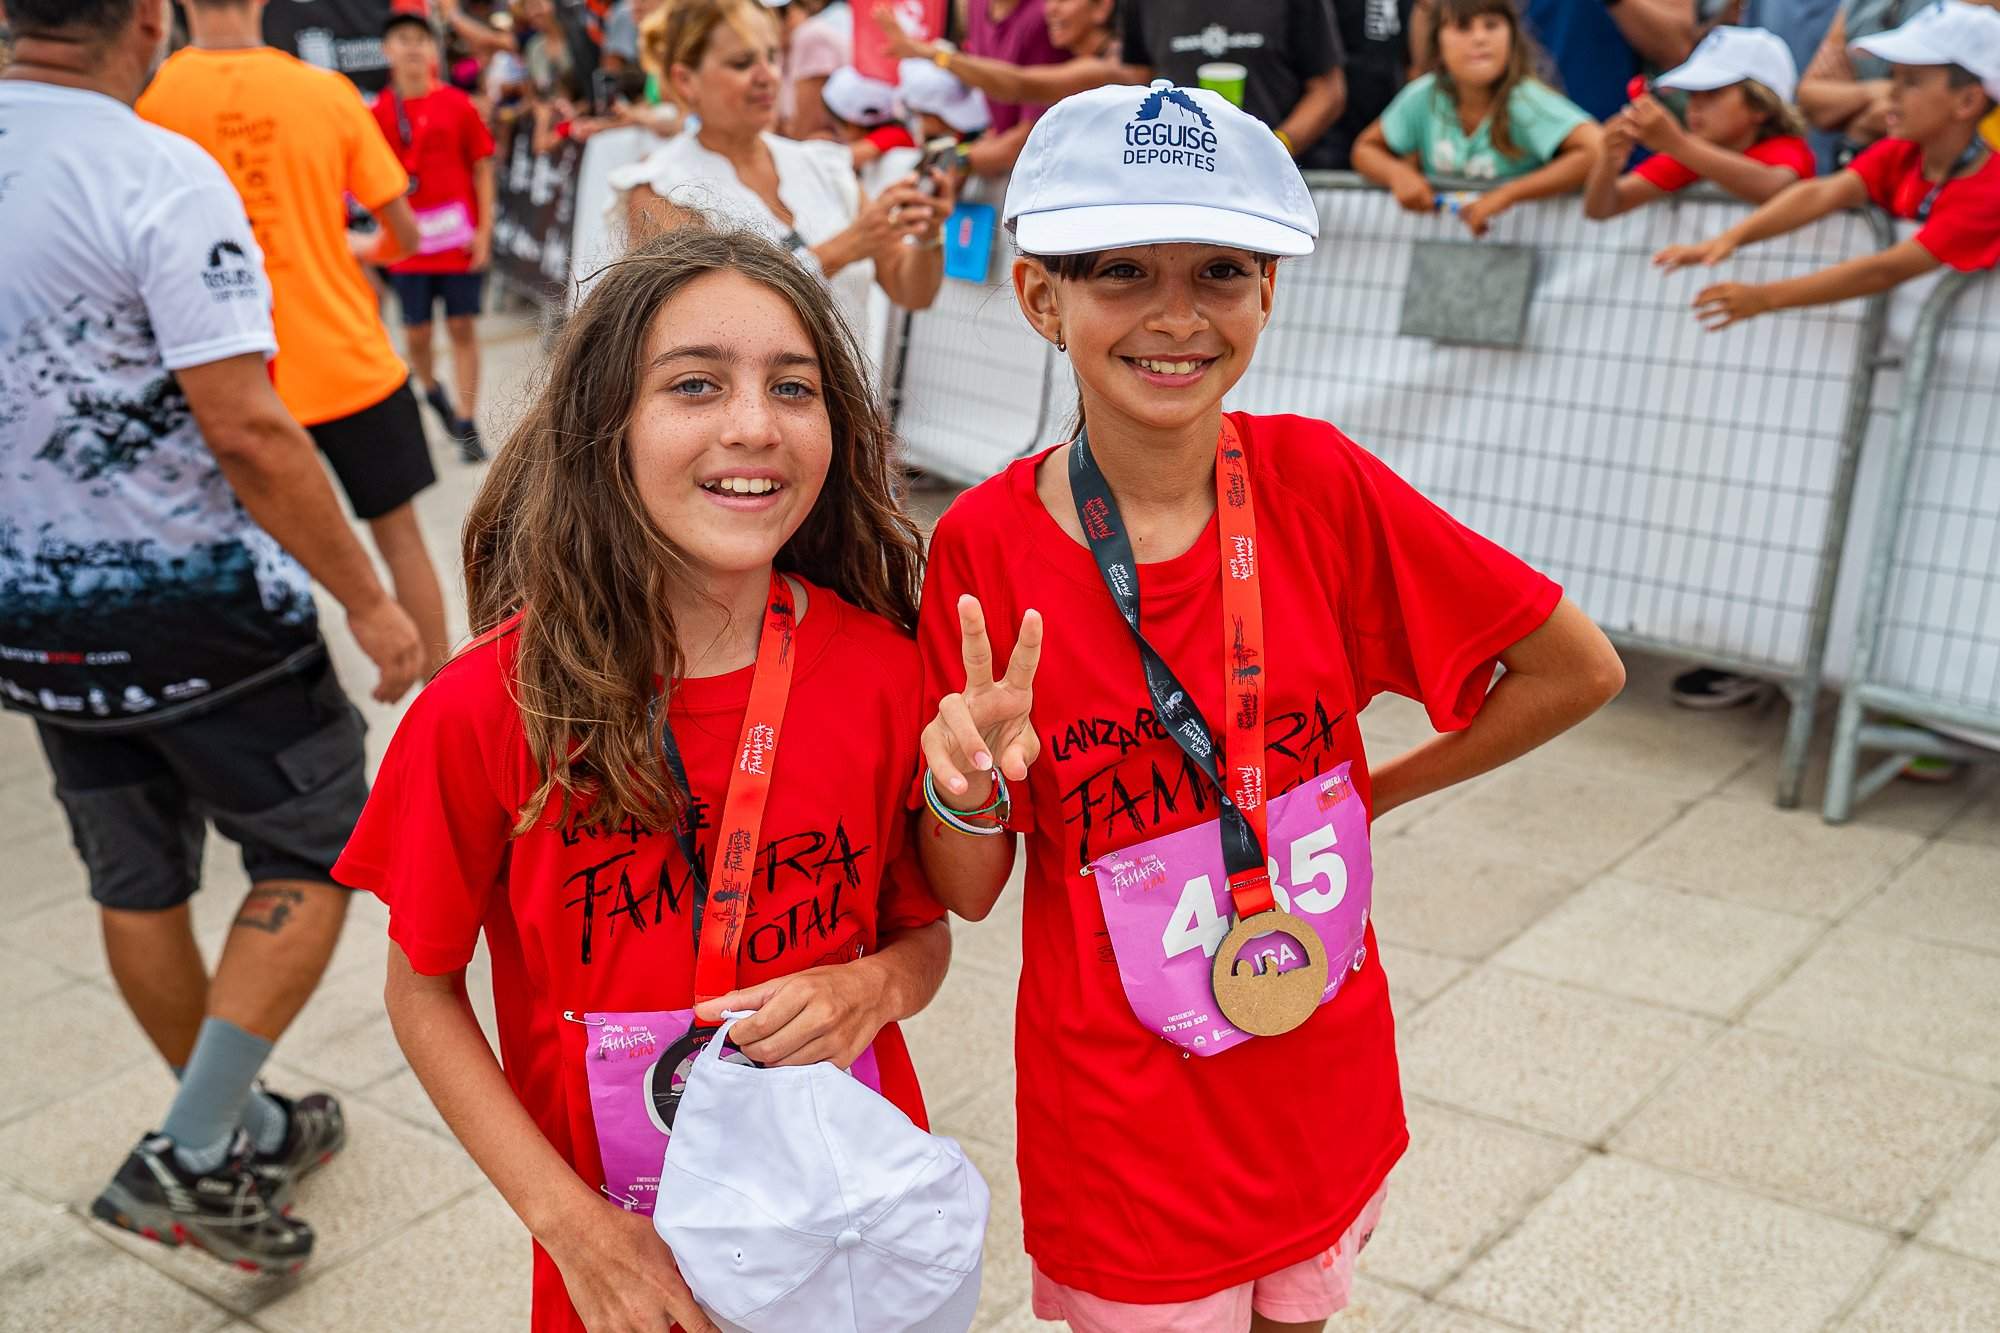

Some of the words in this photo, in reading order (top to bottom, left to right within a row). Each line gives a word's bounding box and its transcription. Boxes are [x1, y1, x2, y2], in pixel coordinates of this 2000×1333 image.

[1124, 149, 1215, 172] DEPORTES
[1230, 535, 1250, 581] FAMARA
[747, 721, 766, 775] FAMARA
[764, 726, 774, 751] TOTAL
[1052, 707, 1169, 761] LANZARO
[1178, 720, 1211, 755] FAMARA
[1235, 790, 1247, 809] TOTAL
[1237, 765, 1257, 812] FAMARA
[563, 815, 871, 965] FAMRA
[1112, 857, 1166, 896] FAMARA
[737, 880, 853, 965] OTAL
[600, 1030, 656, 1058] FAMARA
